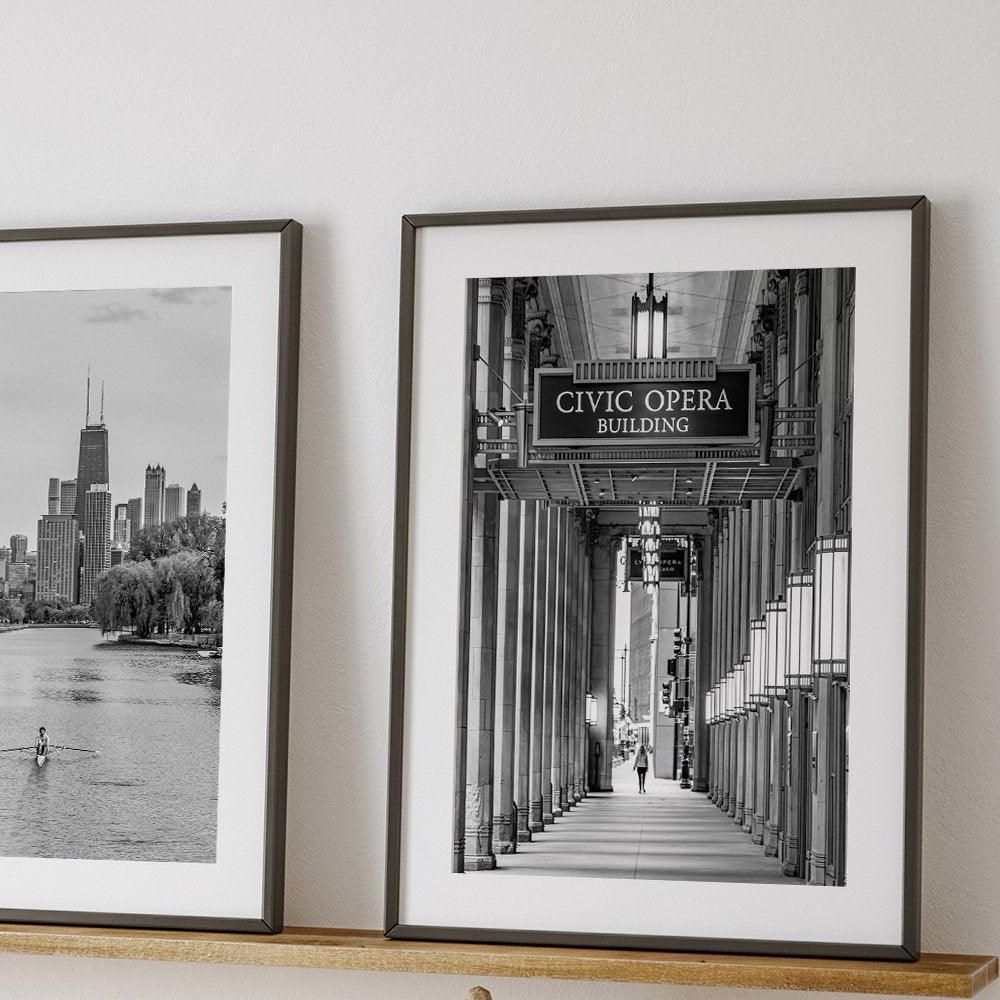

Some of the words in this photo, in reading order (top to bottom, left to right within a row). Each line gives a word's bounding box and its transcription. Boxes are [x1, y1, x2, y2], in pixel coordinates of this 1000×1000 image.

[556, 390, 634, 413] CIVIC
[644, 388, 733, 412] OPERA
[597, 417, 690, 434] BUILDING
